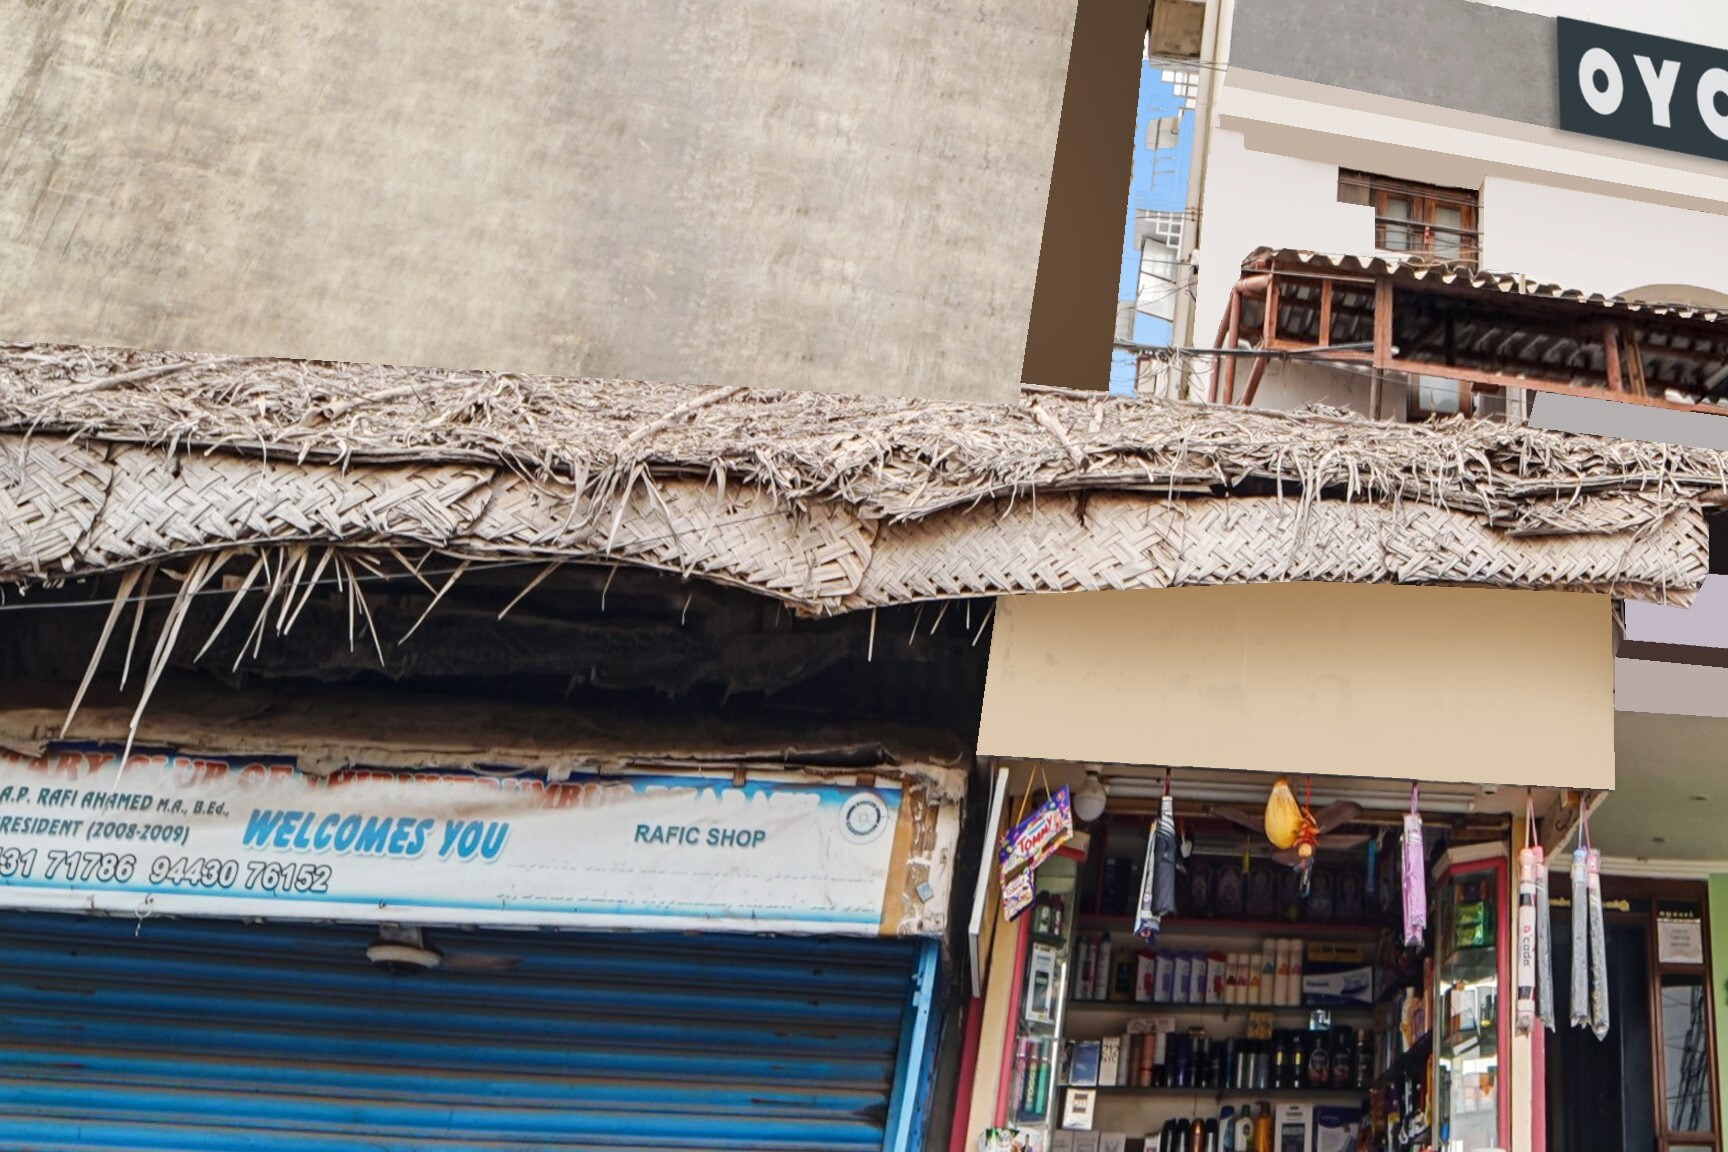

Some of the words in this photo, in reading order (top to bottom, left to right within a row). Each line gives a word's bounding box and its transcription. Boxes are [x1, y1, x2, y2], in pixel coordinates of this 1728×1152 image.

[37, 788, 79, 808] RAFI
[81, 791, 154, 812] AHAMED
[0, 816, 83, 836] RESIDENT
[86, 821, 190, 845] (2008-2009)
[242, 808, 436, 856] WELCOMES
[437, 818, 511, 860] YOU
[634, 824, 700, 846] RAFIC
[706, 827, 766, 848] SHOP
[45, 850, 137, 883] 71786
[150, 856, 239, 889] 94430
[245, 860, 332, 893] 76152
